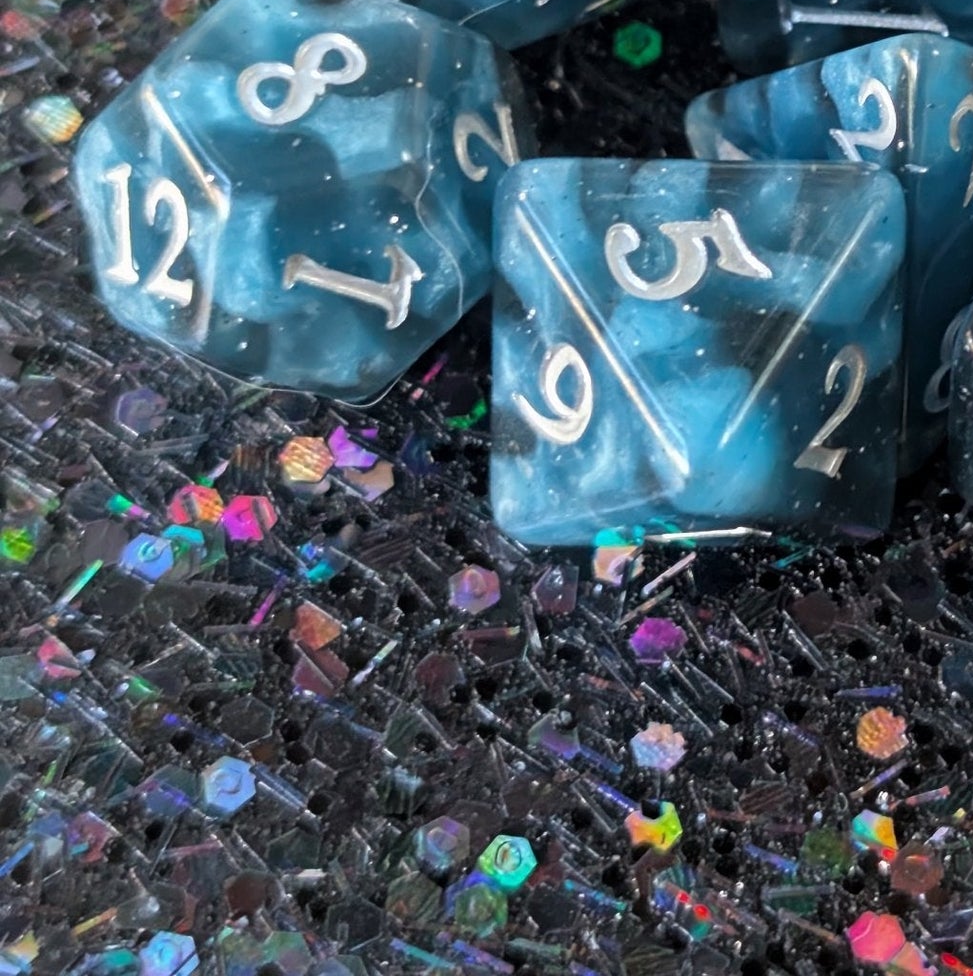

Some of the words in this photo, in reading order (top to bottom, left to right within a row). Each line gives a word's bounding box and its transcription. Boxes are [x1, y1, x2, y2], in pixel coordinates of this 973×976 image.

[237, 32, 368, 125] 8
[453, 102, 520, 182] 2
[104, 162, 194, 308] 12
[604, 208, 773, 301] 5
[793, 344, 867, 479] 2
